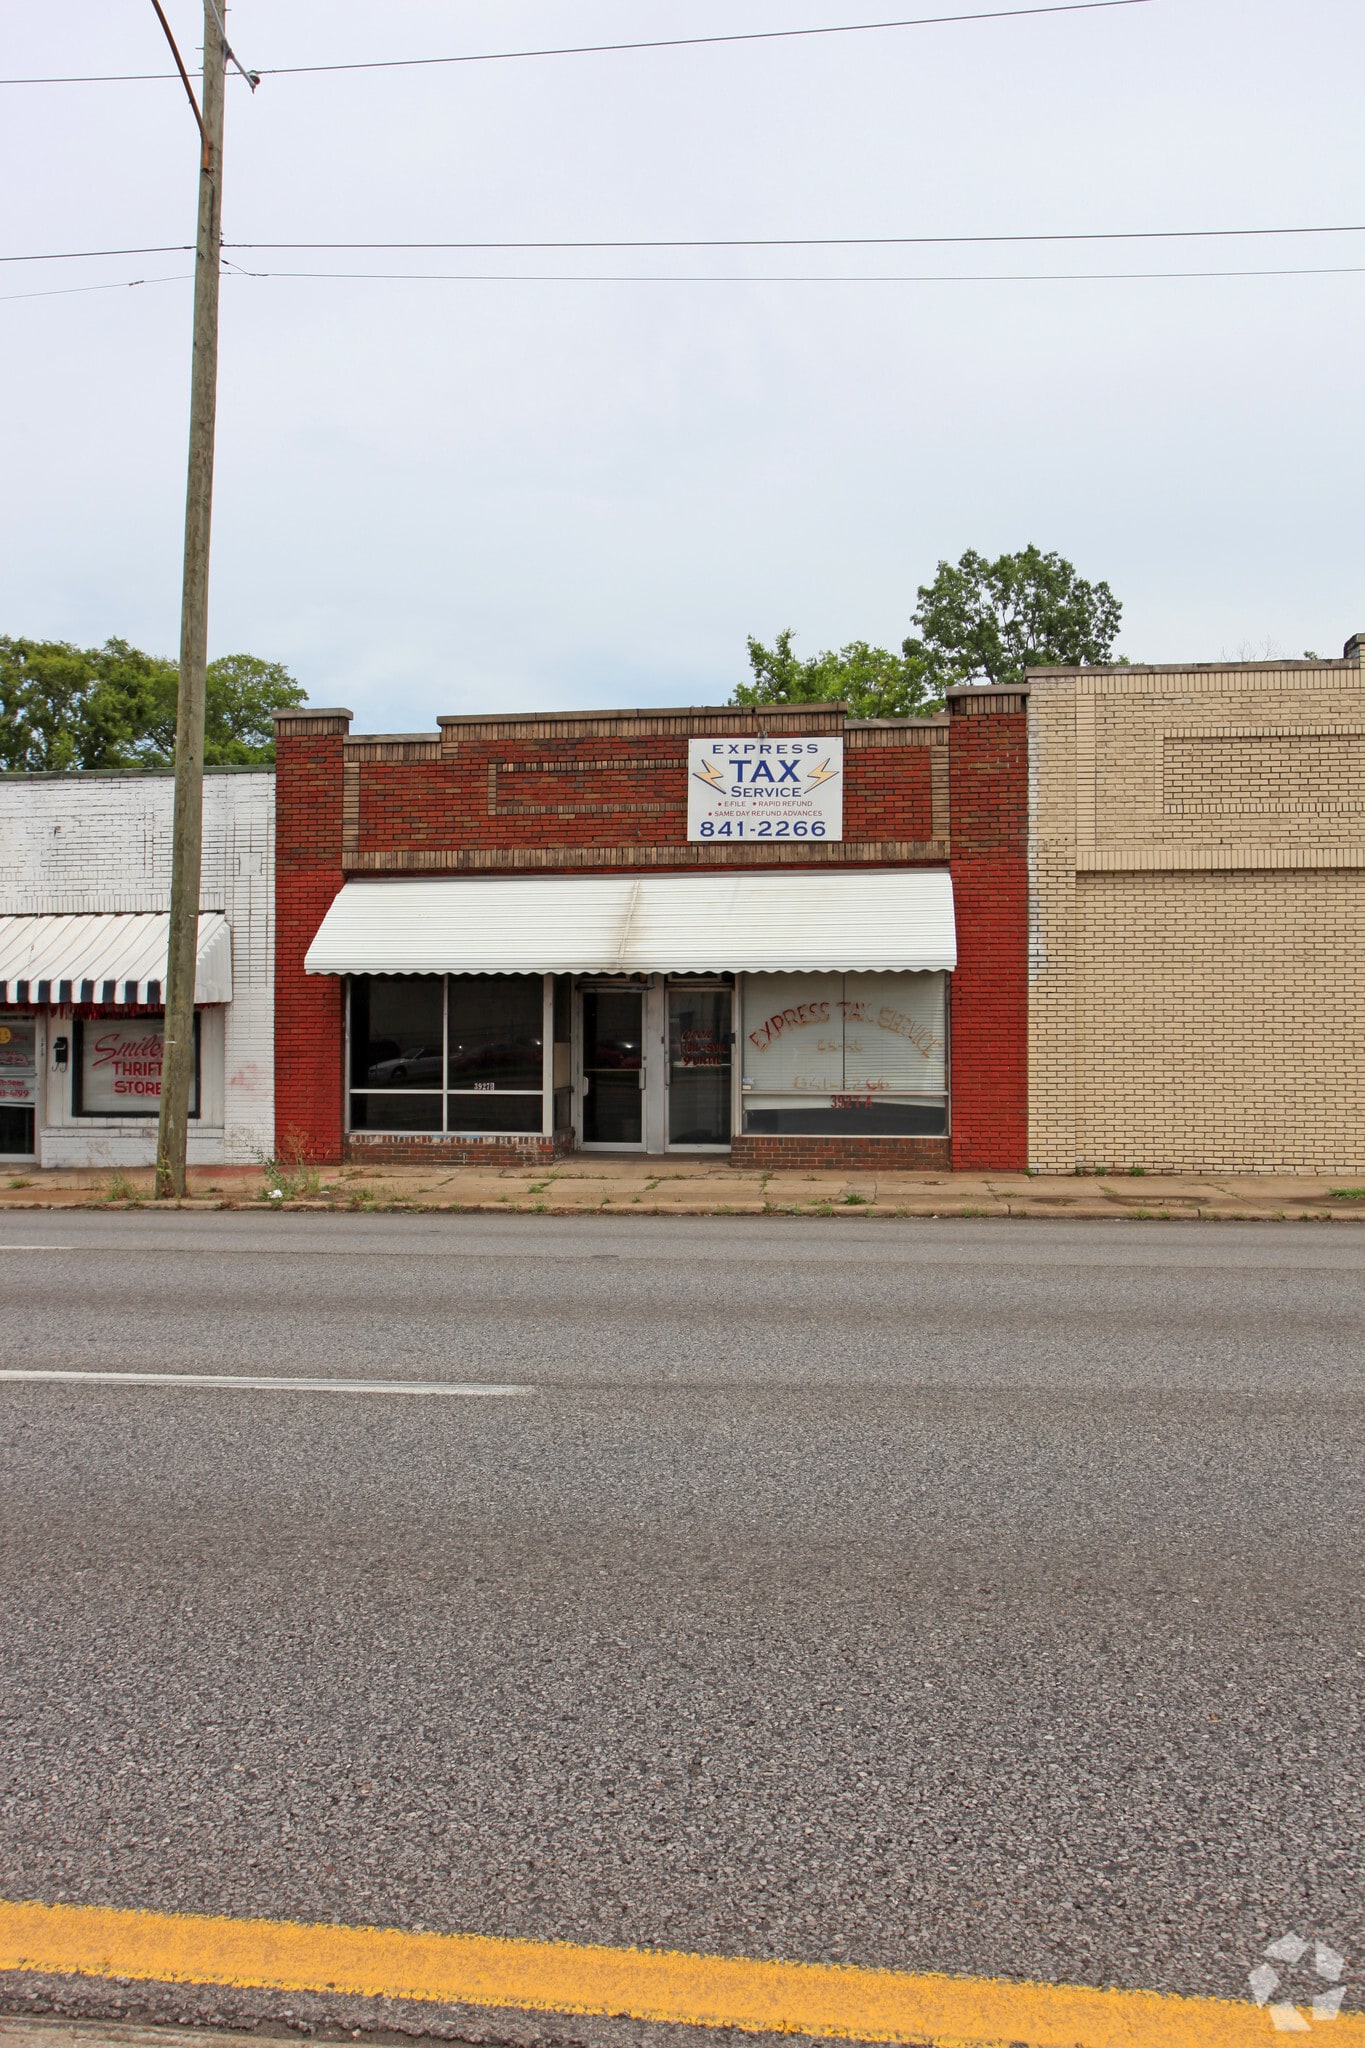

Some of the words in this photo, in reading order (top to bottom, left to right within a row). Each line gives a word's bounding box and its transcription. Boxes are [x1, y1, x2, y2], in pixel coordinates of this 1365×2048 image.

[712, 743, 819, 755] EXPRESS
[728, 759, 802, 783] TAX
[730, 785, 802, 798] SERVICE
[699, 820, 826, 837] 841-2266
[748, 1001, 831, 1053] EXPRESS
[91, 1033, 164, 1066] Smile
[112, 1061, 163, 1077] THRIFT
[114, 1080, 162, 1095] STORE
